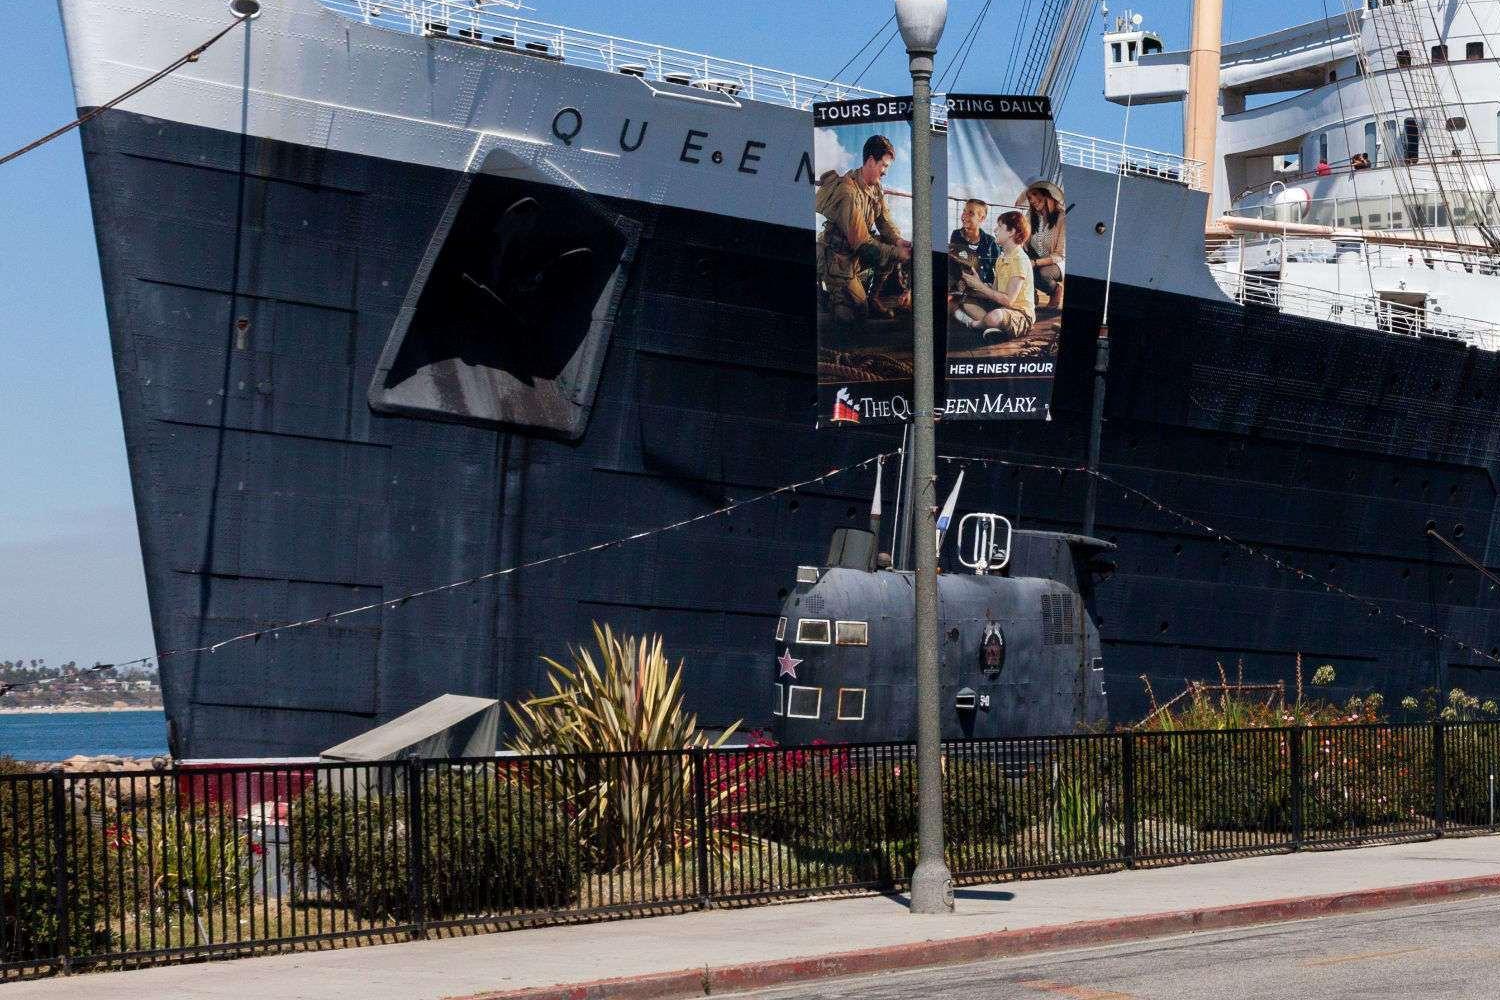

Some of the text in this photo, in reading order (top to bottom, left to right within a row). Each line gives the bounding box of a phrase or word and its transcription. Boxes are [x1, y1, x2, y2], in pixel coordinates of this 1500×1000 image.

[818, 103, 871, 120] TOURS
[1000, 99, 1045, 114] DAILY
[950, 362, 1053, 375] HER FINEST HOUR
